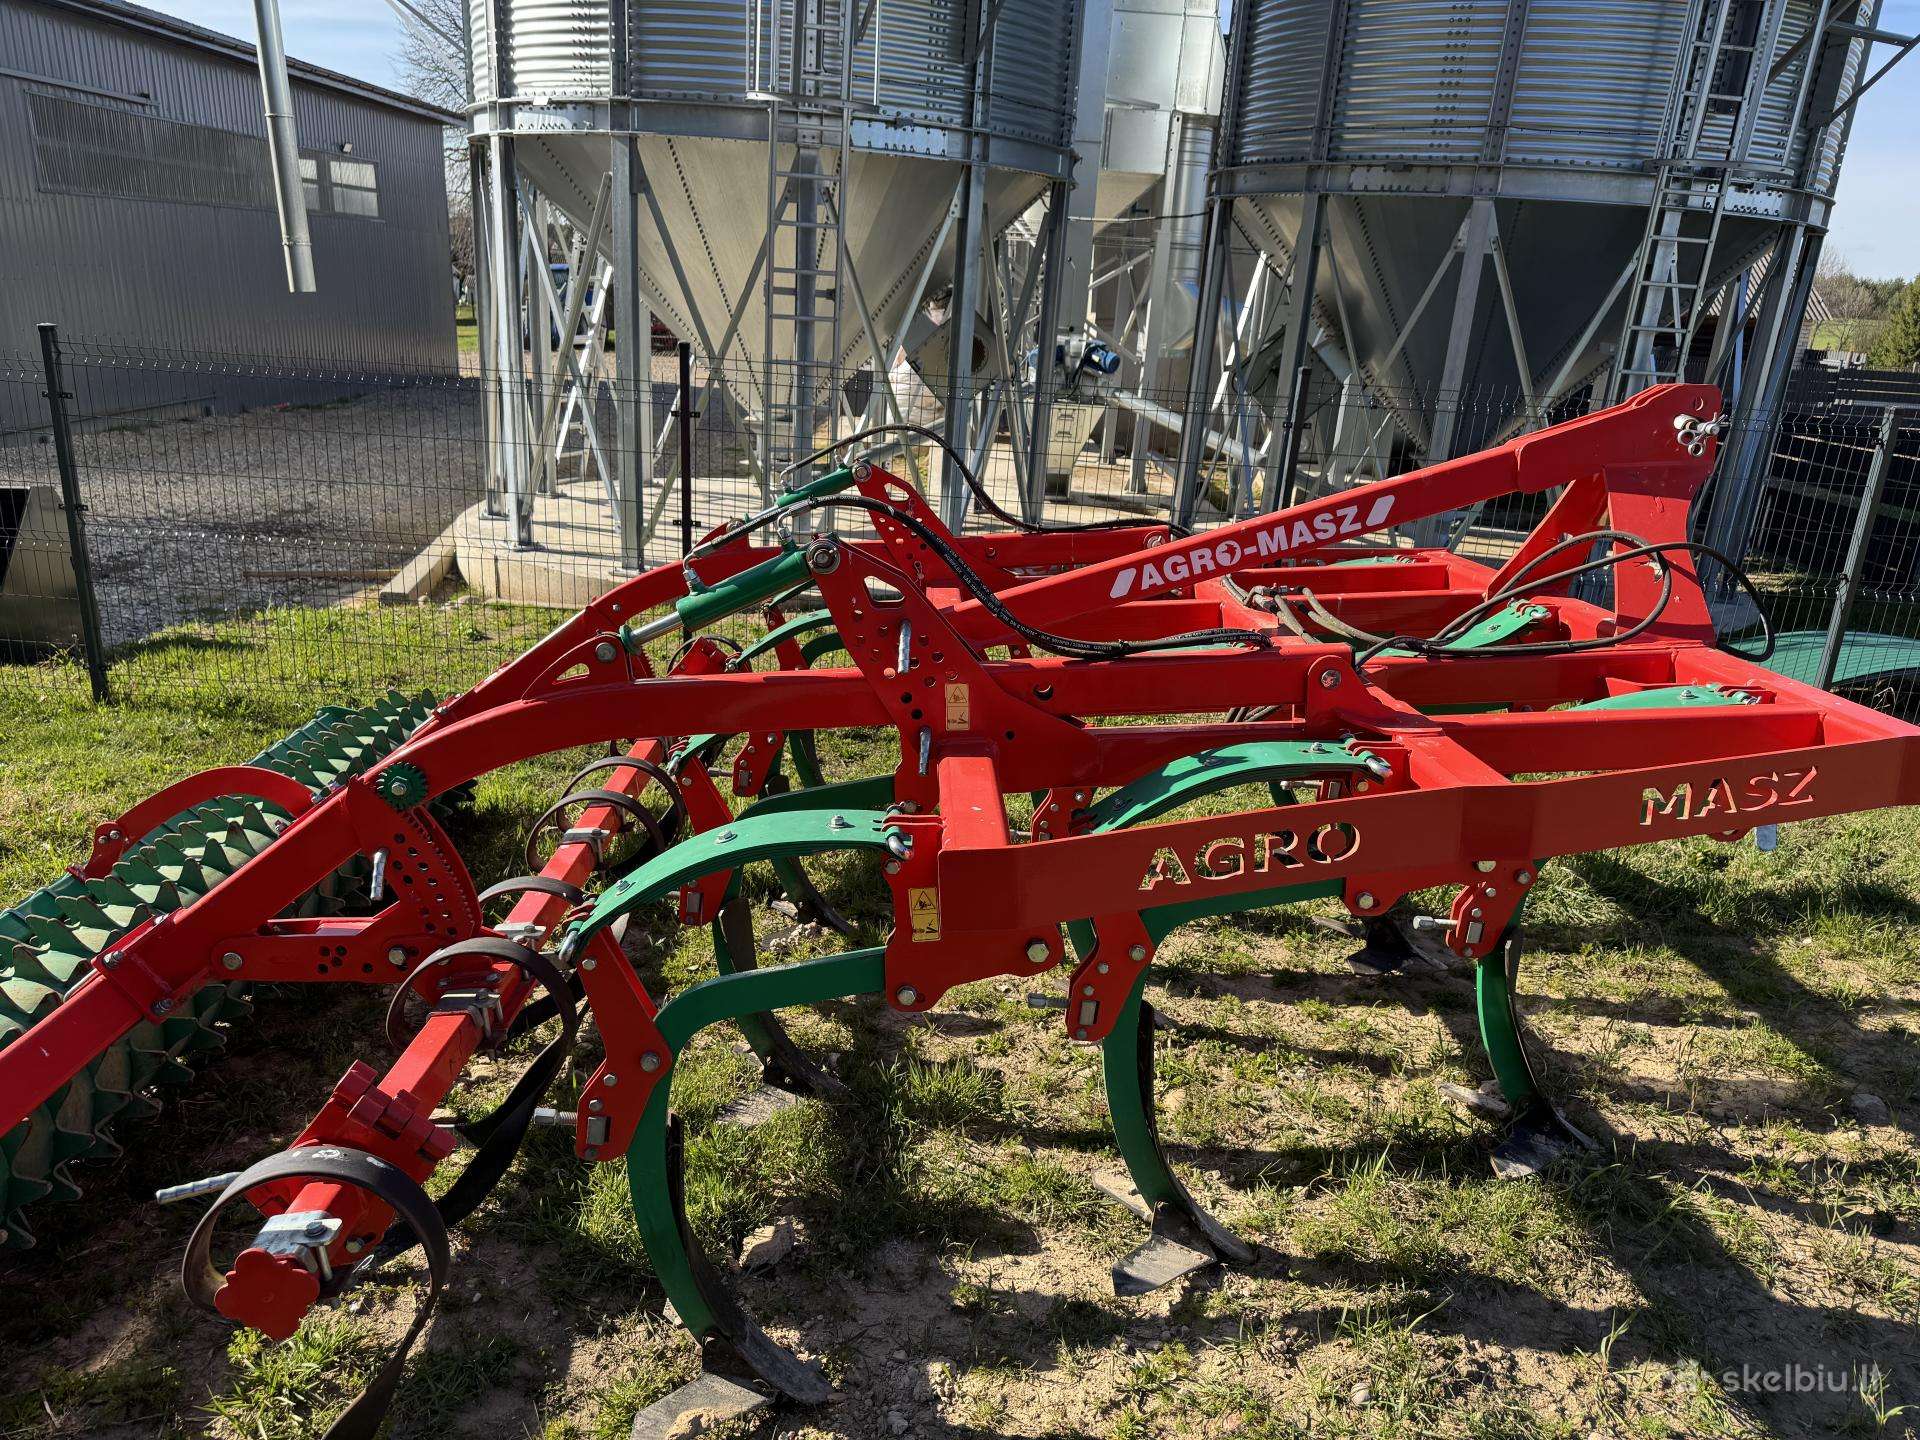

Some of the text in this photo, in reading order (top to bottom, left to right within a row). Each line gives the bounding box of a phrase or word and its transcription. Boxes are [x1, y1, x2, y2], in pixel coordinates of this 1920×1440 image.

[1140, 505, 1362, 591] AGRO-MASZ
[1137, 765, 1818, 891] AGRO MASZ
